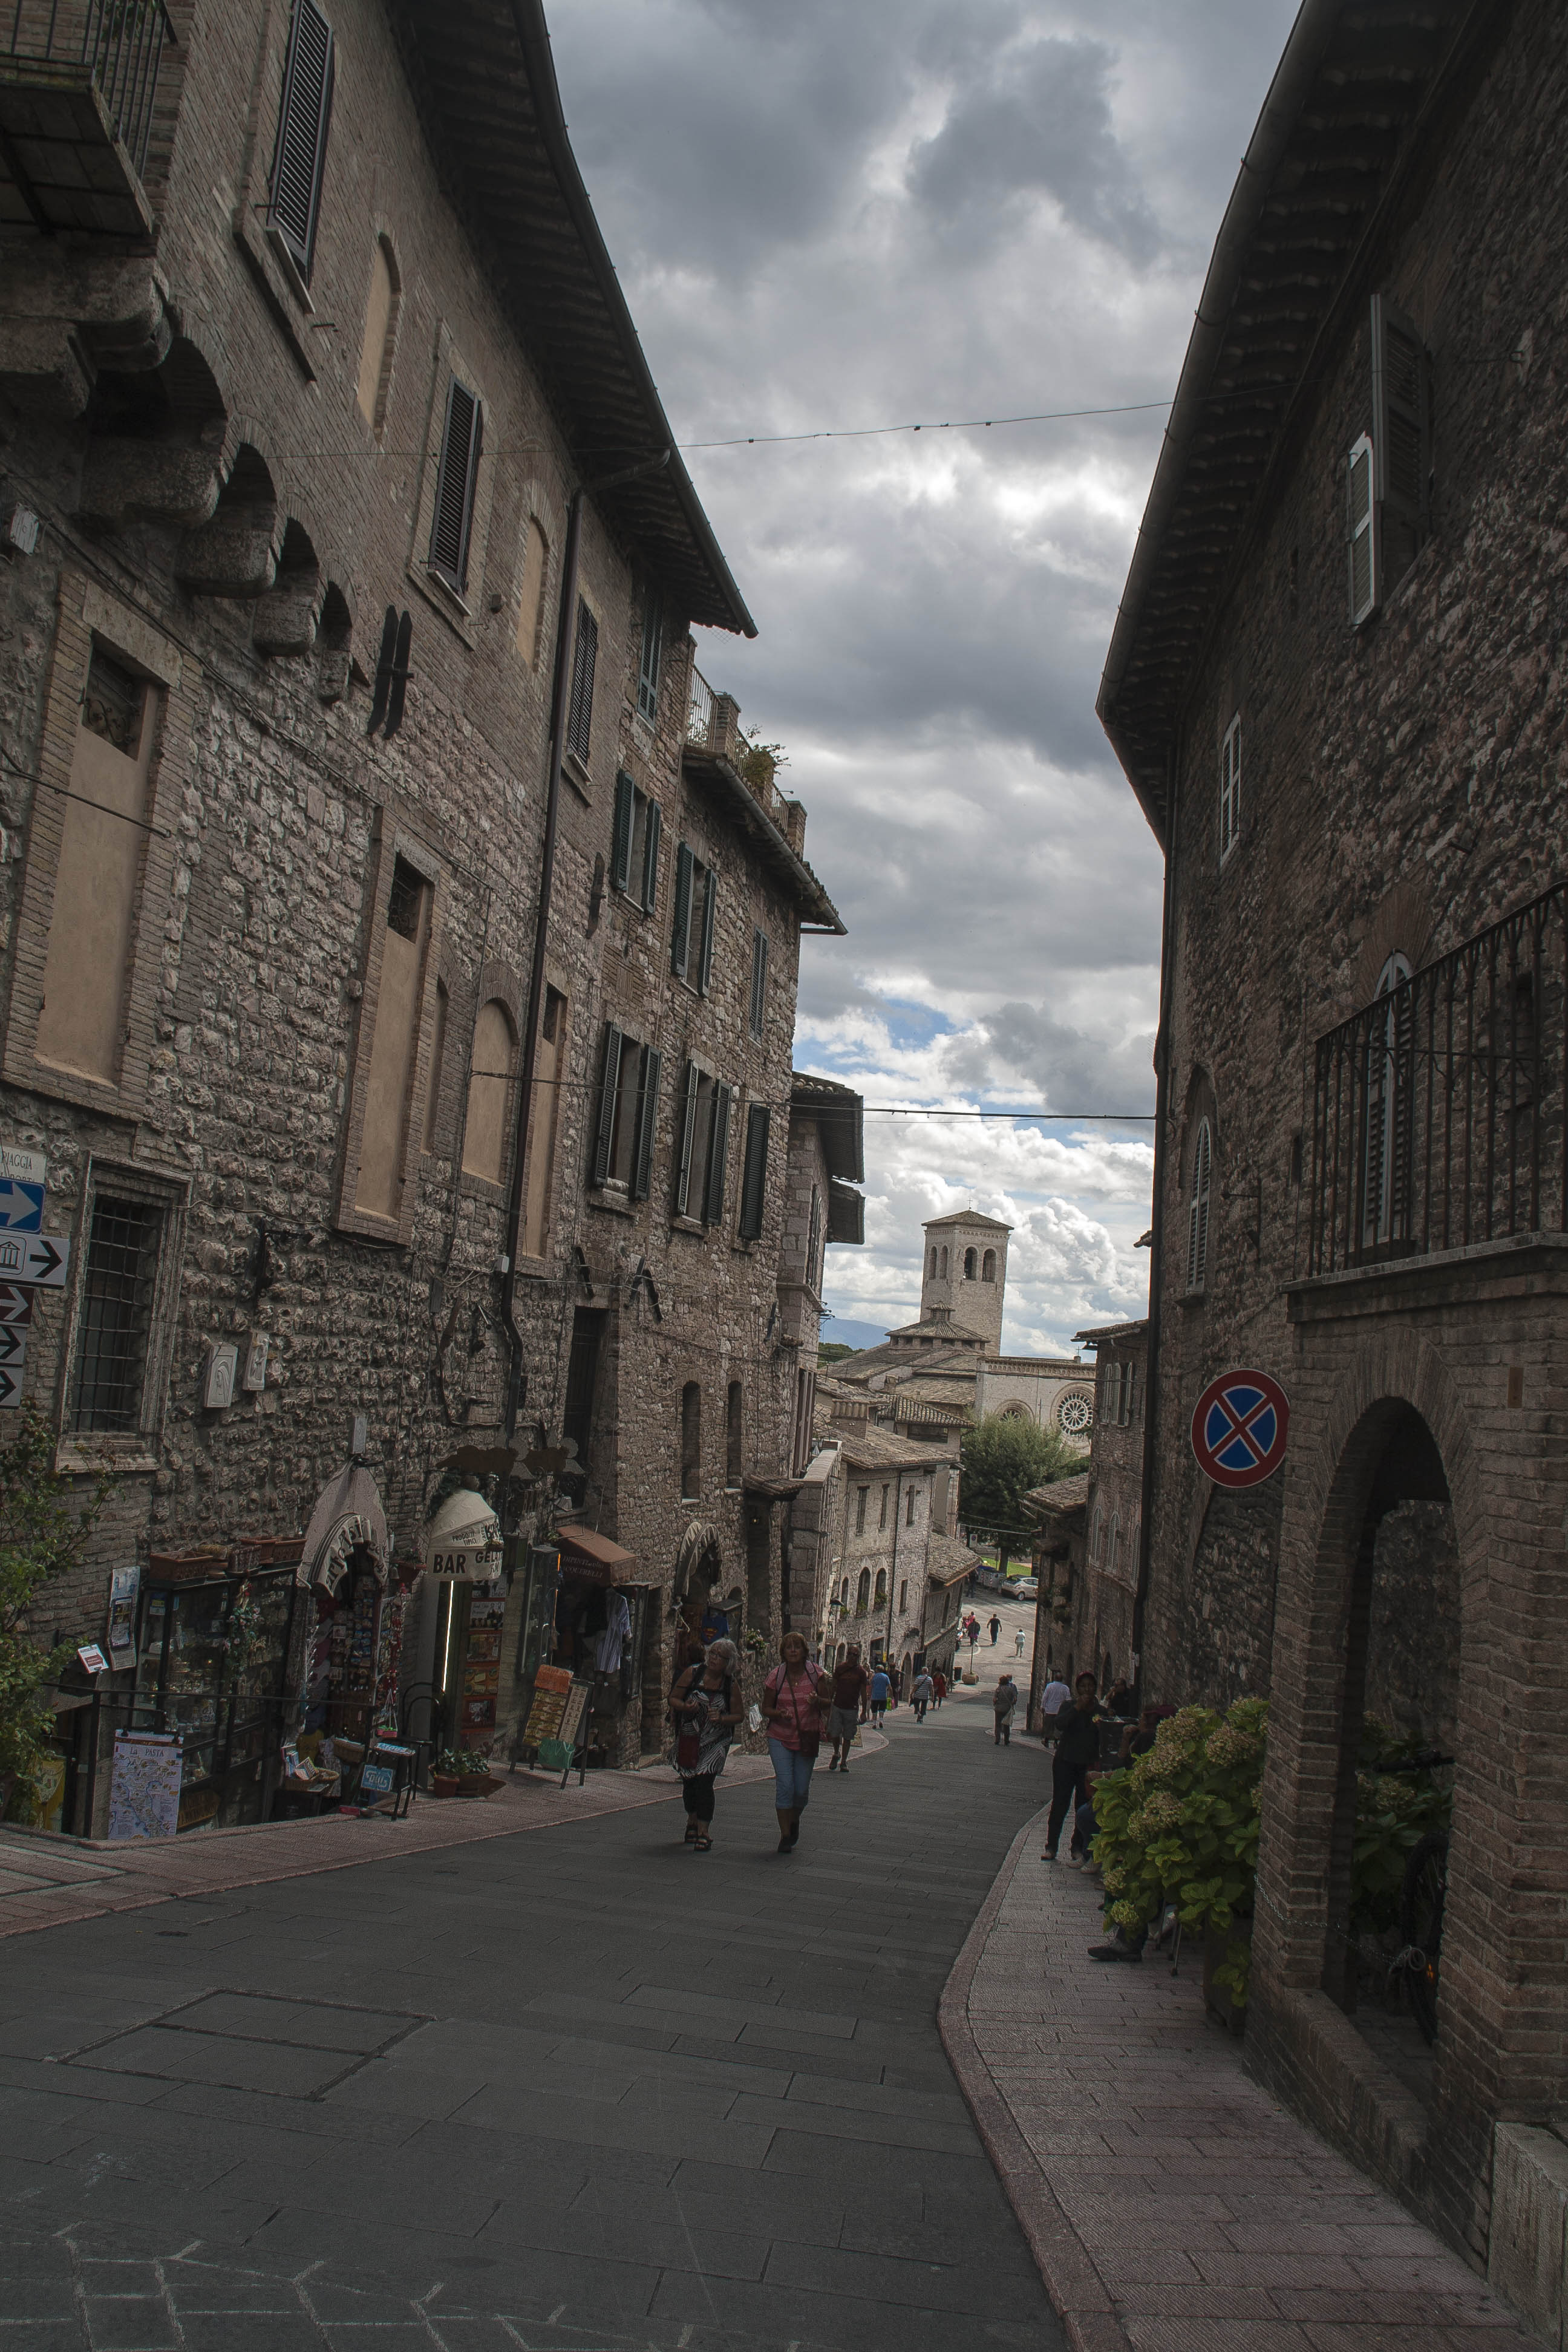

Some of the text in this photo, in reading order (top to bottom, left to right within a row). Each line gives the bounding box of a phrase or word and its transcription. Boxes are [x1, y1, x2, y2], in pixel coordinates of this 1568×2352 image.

[433, 1554, 466, 1574] BAR
[130, 1746, 165, 1757] La PASTA
